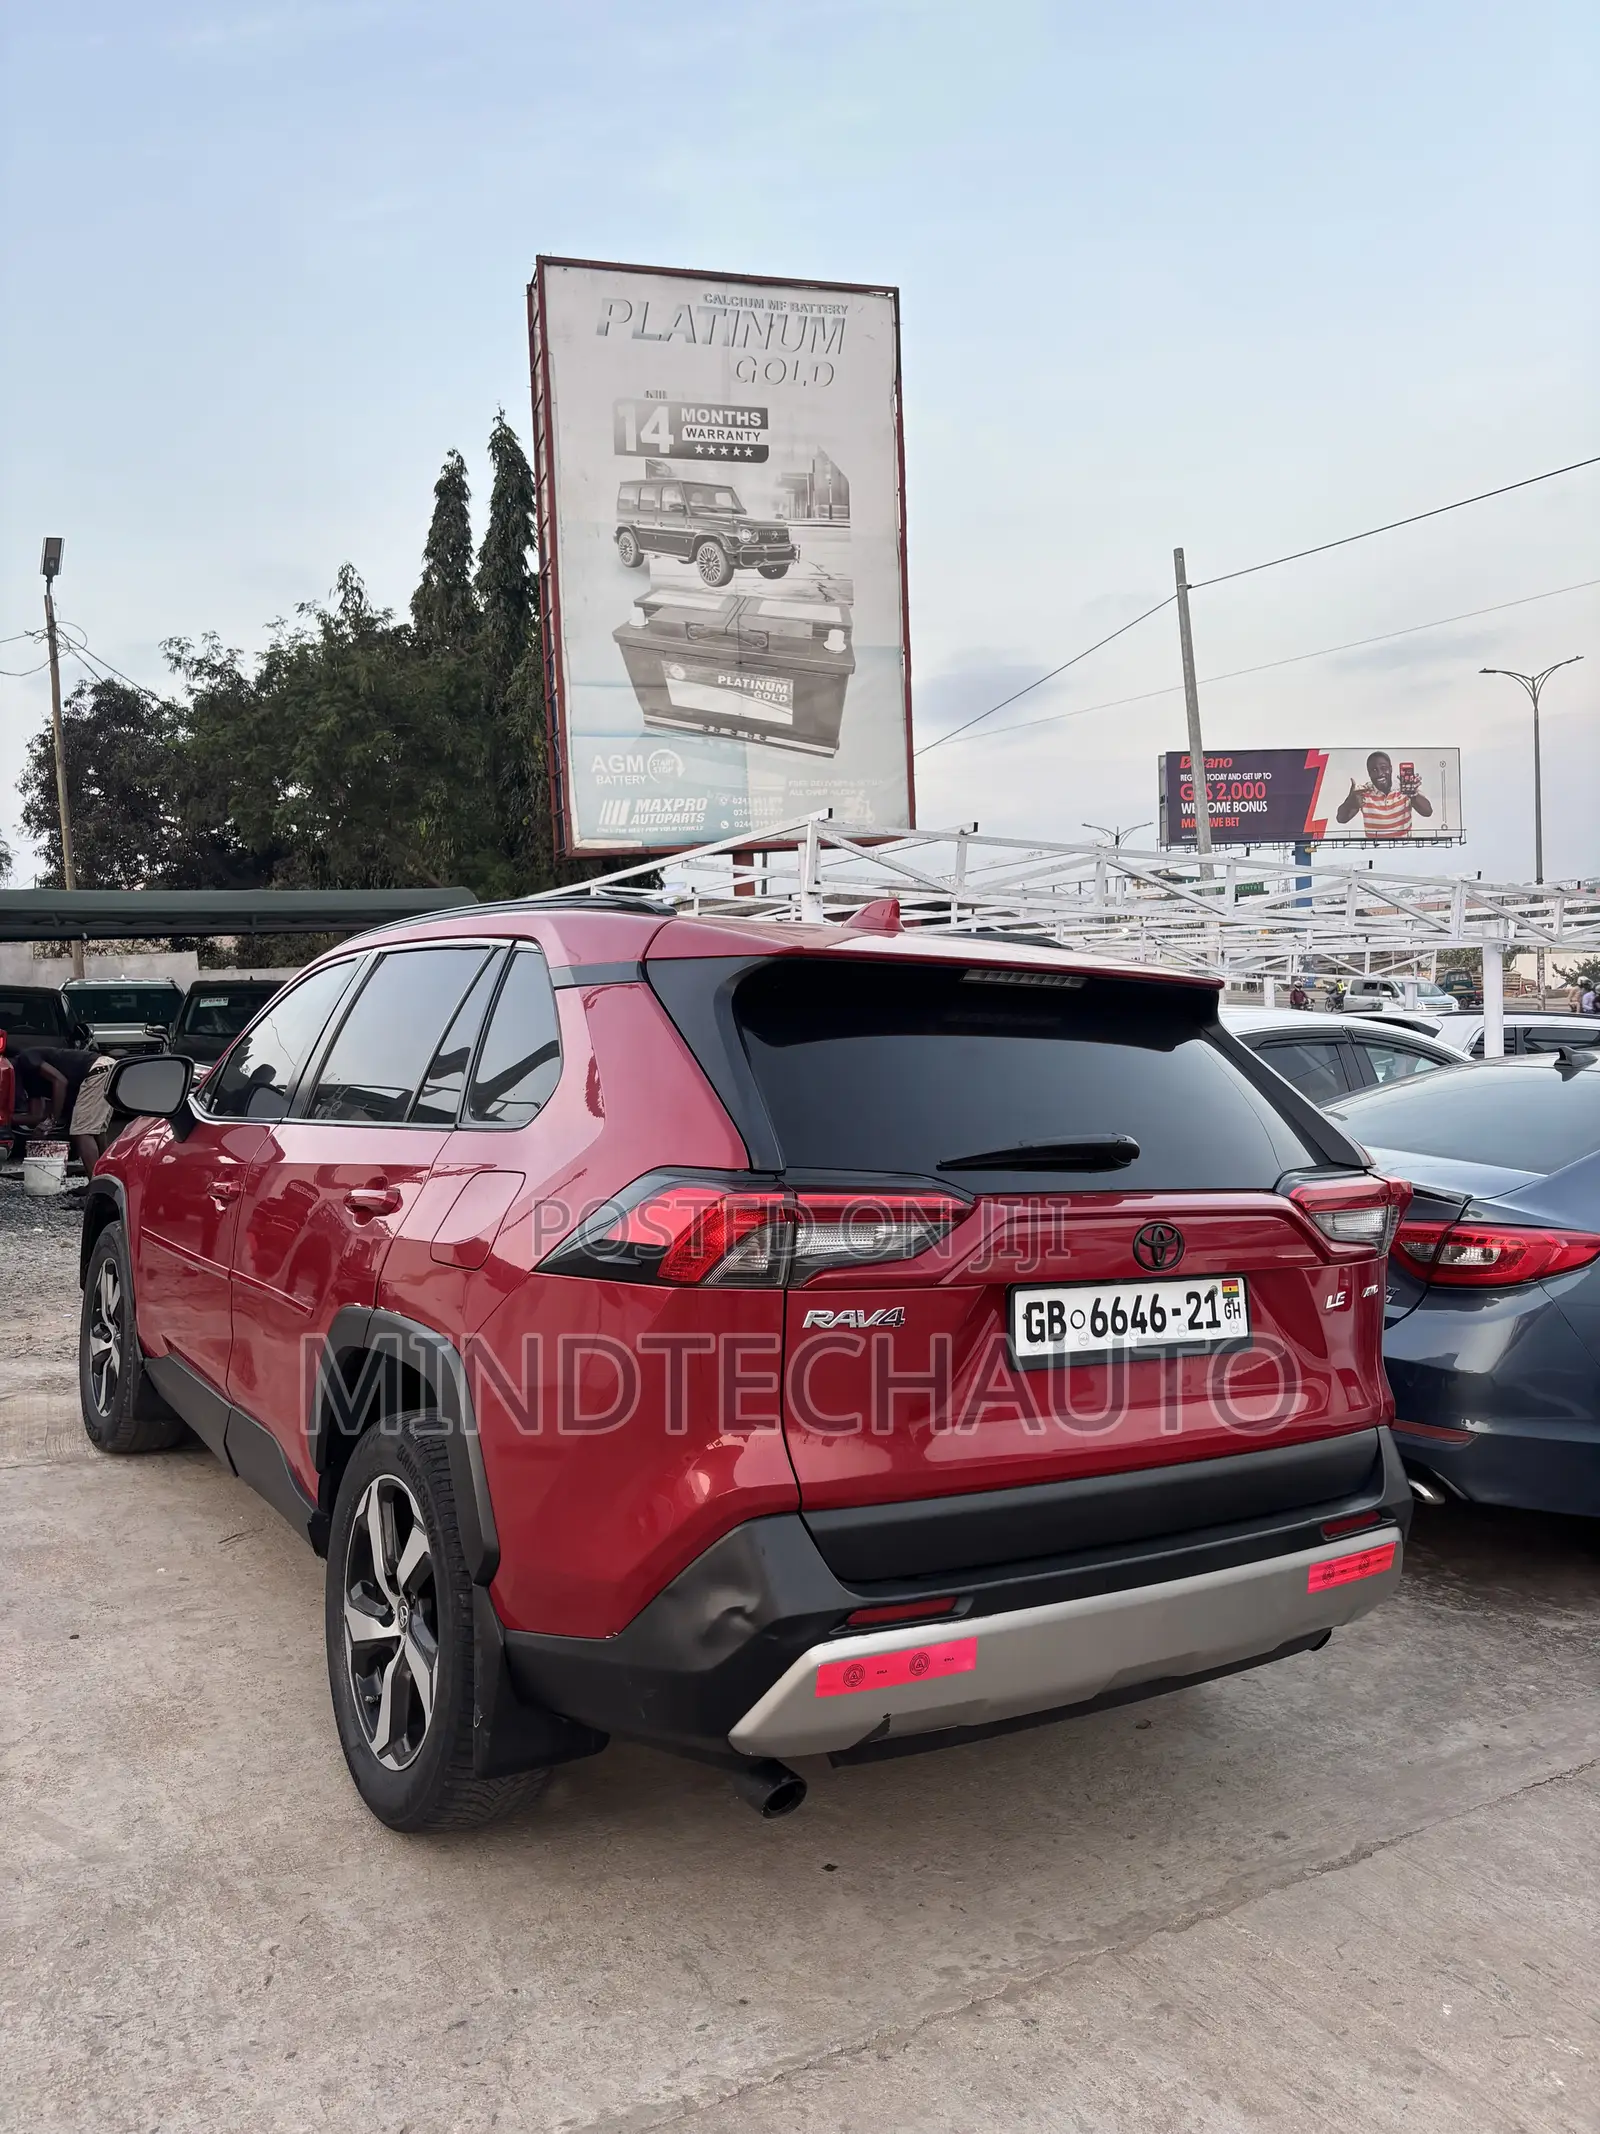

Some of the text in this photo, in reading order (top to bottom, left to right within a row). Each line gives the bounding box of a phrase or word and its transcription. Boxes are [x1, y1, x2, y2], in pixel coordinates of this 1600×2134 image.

[703, 292, 849, 315] CALCIUM MF BATTERY
[596, 297, 846, 354] PLATINUM
[735, 355, 835, 387] GOLD
[614, 404, 762, 454] 14 MONTHS
[684, 427, 762, 443] WARRANTY
[717, 674, 788, 694] PLATINUM
[753, 690, 788, 703] GOLD
[590, 753, 644, 774] AGM
[651, 758, 676, 767] START
[652, 766, 673, 774] STOP
[1179, 755, 1233, 769] Btano
[596, 775, 647, 786] BATTERY
[1207, 772, 1273, 781] TODAY AND GET UP TO
[1179, 781, 1267, 801] GS 2,000
[634, 797, 708, 813] MAXPRO
[1181, 800, 1268, 814] WEOME BONUS
[630, 812, 706, 826] AUTOPARTS
[1224, 817, 1240, 827] BET
[1324, 1291, 1346, 1310] LE
[802, 1306, 906, 1329] RAV4
[1024, 1290, 1222, 1343] GB 6646-21
[1224, 1300, 1242, 1320] GH
